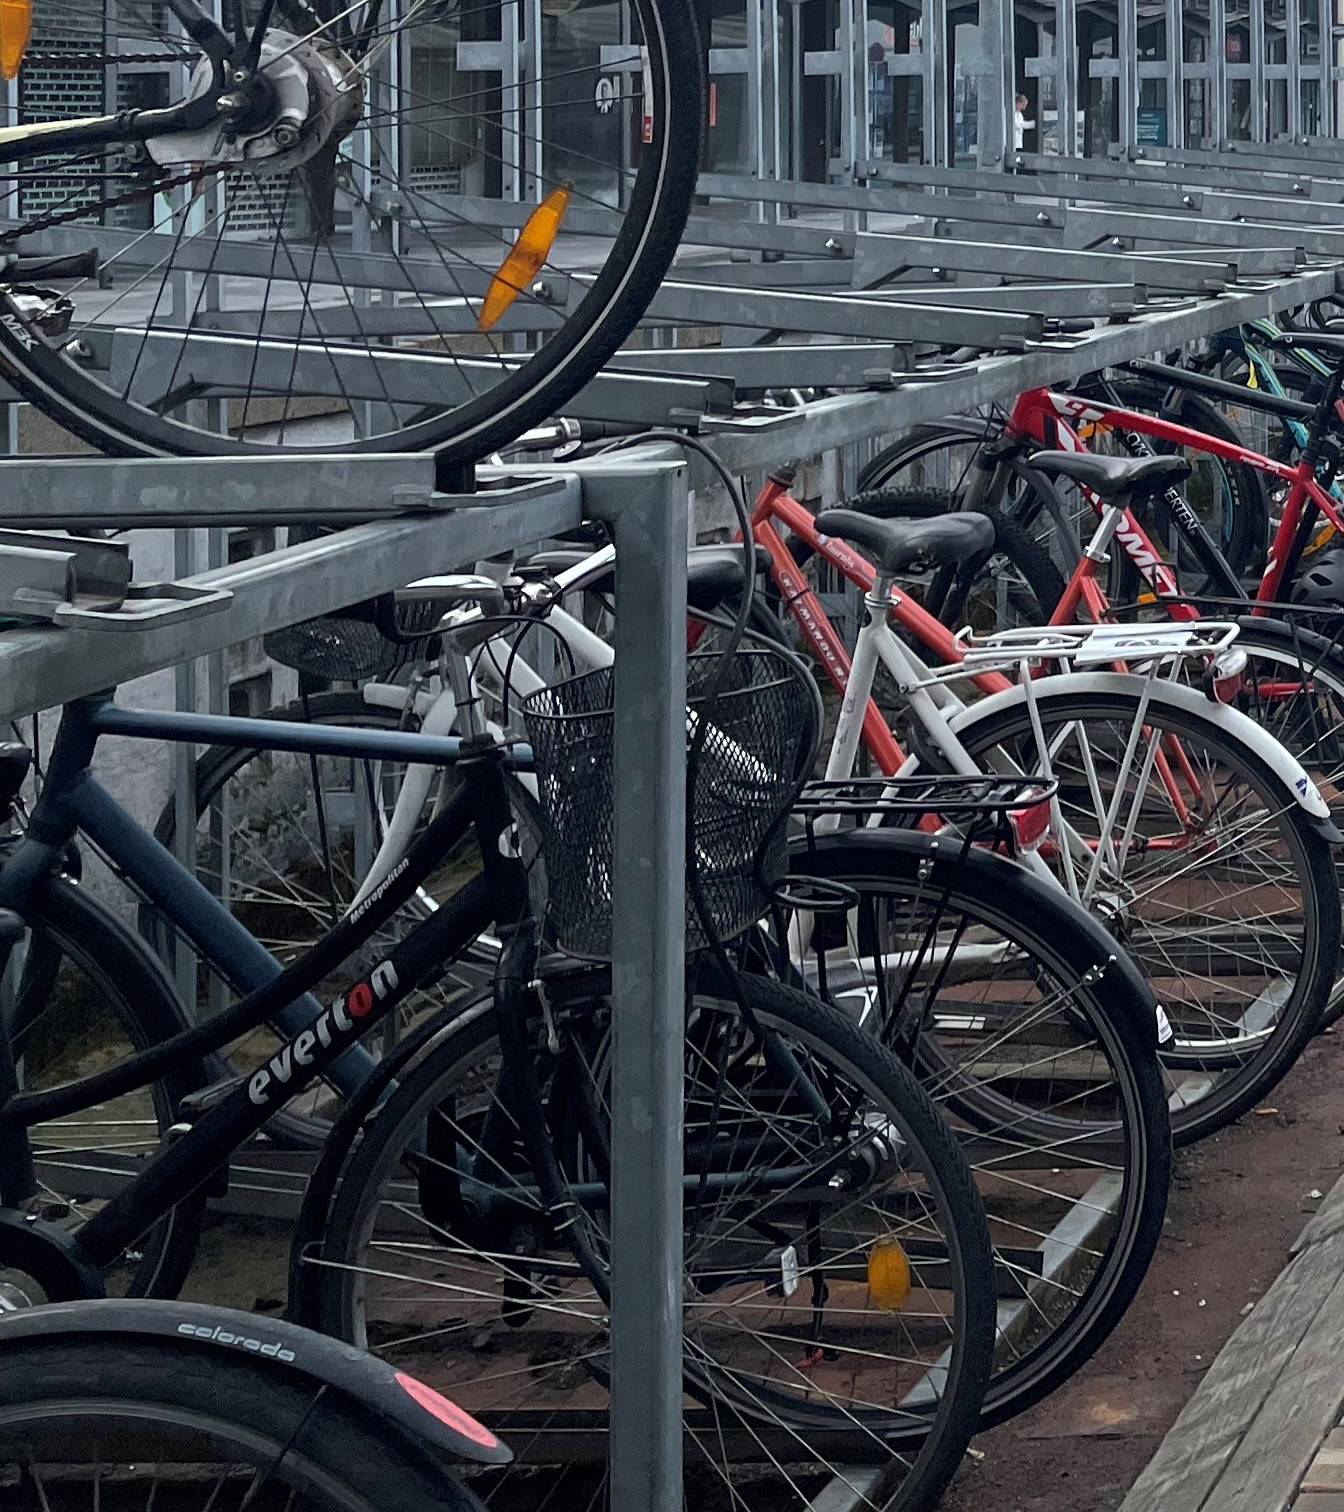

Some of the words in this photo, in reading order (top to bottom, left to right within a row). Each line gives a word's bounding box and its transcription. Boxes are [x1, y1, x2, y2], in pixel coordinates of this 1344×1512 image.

[350, 857, 410, 925] Metropolitan
[249, 960, 399, 1105] everton
[177, 1323, 296, 1362] colorado
